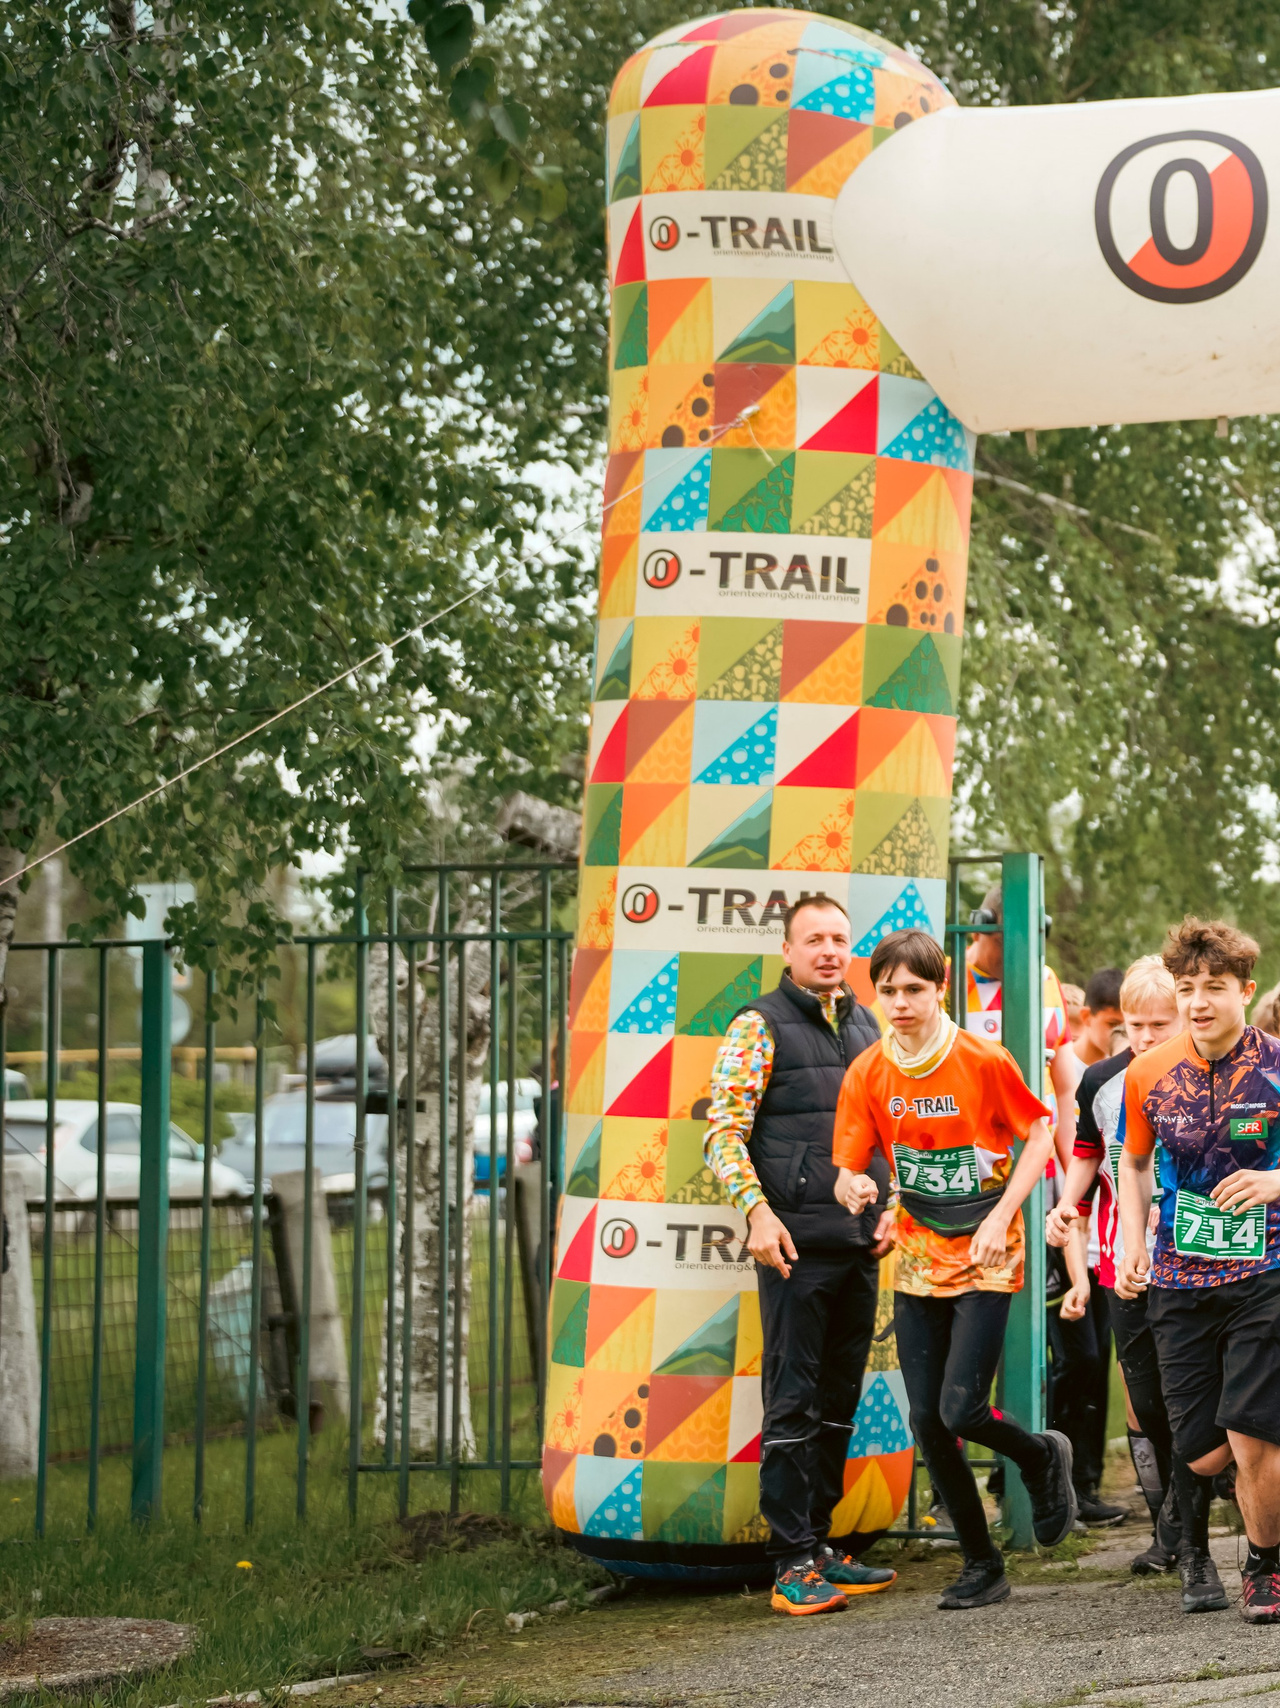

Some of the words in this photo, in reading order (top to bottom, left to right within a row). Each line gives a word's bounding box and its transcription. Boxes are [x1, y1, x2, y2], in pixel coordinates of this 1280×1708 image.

[718, 589, 860, 604] orienteering&trailrunning
[1237, 1122, 1260, 1133] SFR
[900, 1160, 975, 1193] 734
[1182, 1211, 1258, 1248] 714
